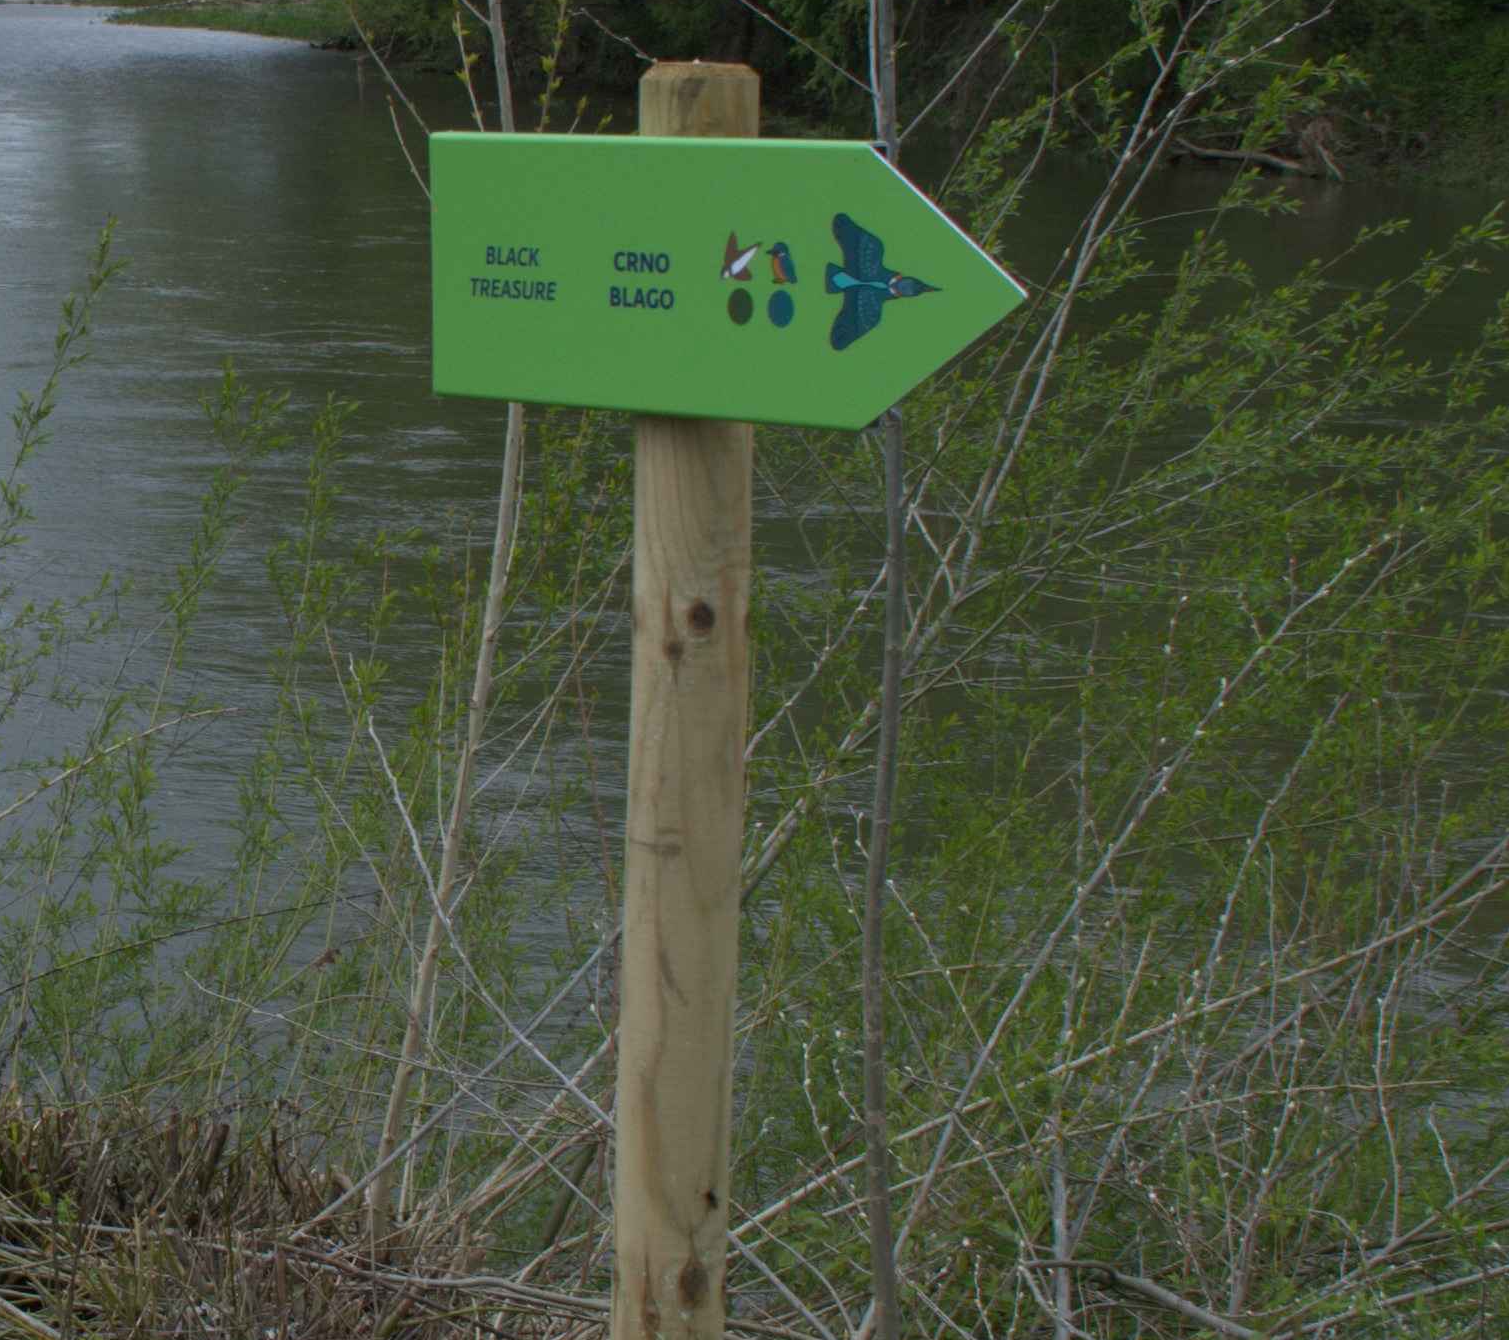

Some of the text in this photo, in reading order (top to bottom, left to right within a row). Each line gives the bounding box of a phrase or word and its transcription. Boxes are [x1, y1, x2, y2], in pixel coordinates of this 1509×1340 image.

[485, 246, 540, 267] BLACK
[613, 251, 670, 275] CRNO
[470, 278, 557, 301] TREASURE
[609, 285, 674, 311] BLAGO
